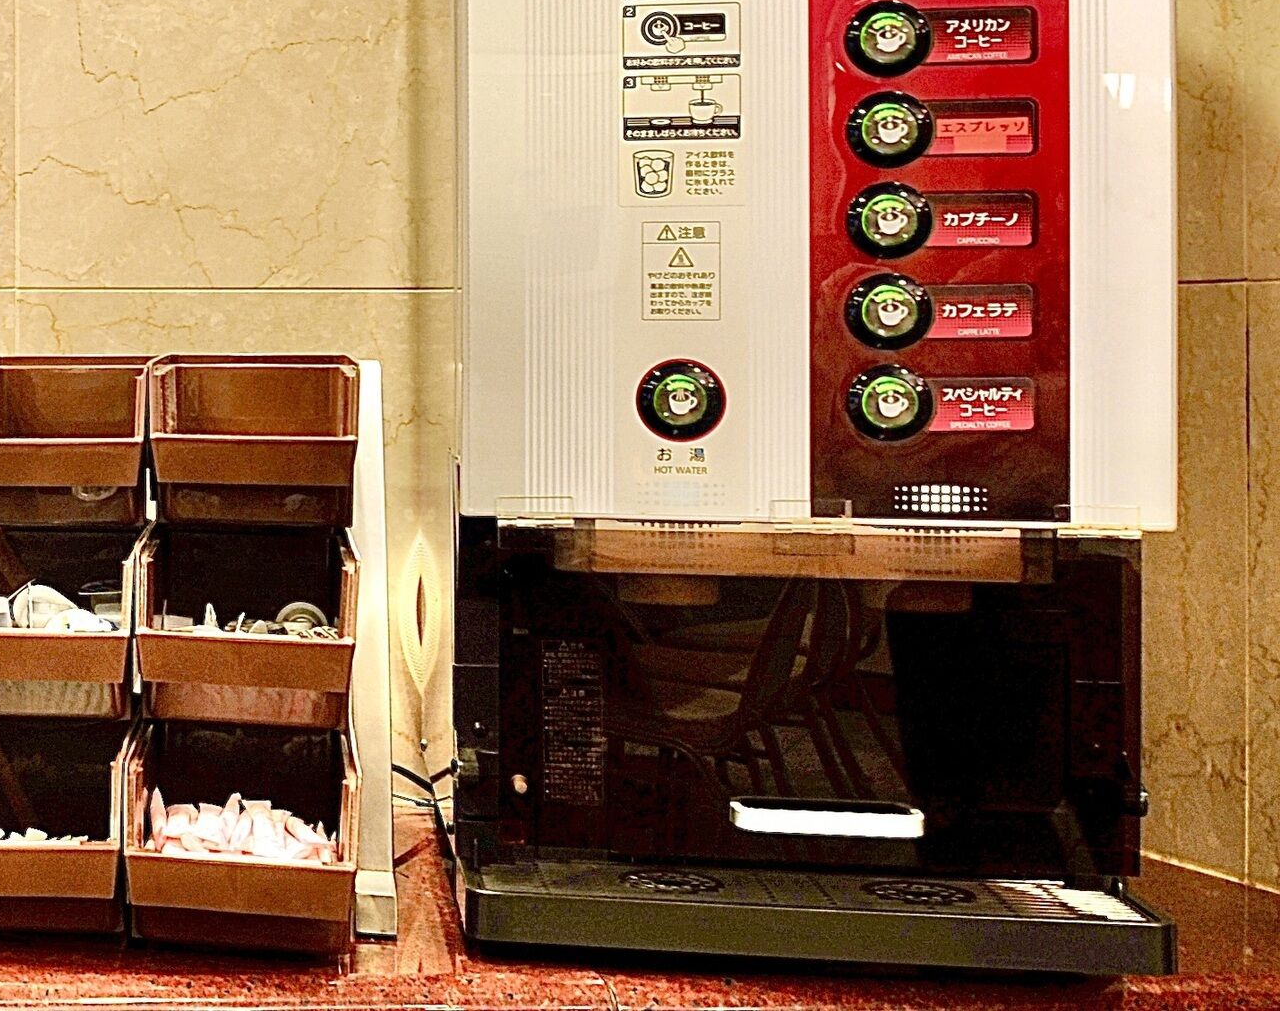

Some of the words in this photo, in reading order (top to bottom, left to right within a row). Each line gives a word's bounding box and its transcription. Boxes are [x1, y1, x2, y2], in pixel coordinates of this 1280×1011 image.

[625, 7, 634, 16] 2
[684, 22, 721, 31] コーヒー
[946, 18, 1011, 33] アメリカン
[954, 35, 1003, 49] コーヒー
[626, 78, 634, 87] 3
[941, 119, 1026, 133] エスプレッソ
[943, 212, 1019, 227] カプチーノ
[942, 303, 1019, 318] カフェラテ
[942, 388, 1023, 402] スペシャルティ
[959, 404, 1008, 417] コーヒー
[654, 466, 673, 474] HOT
[675, 466, 708, 475] WATER
